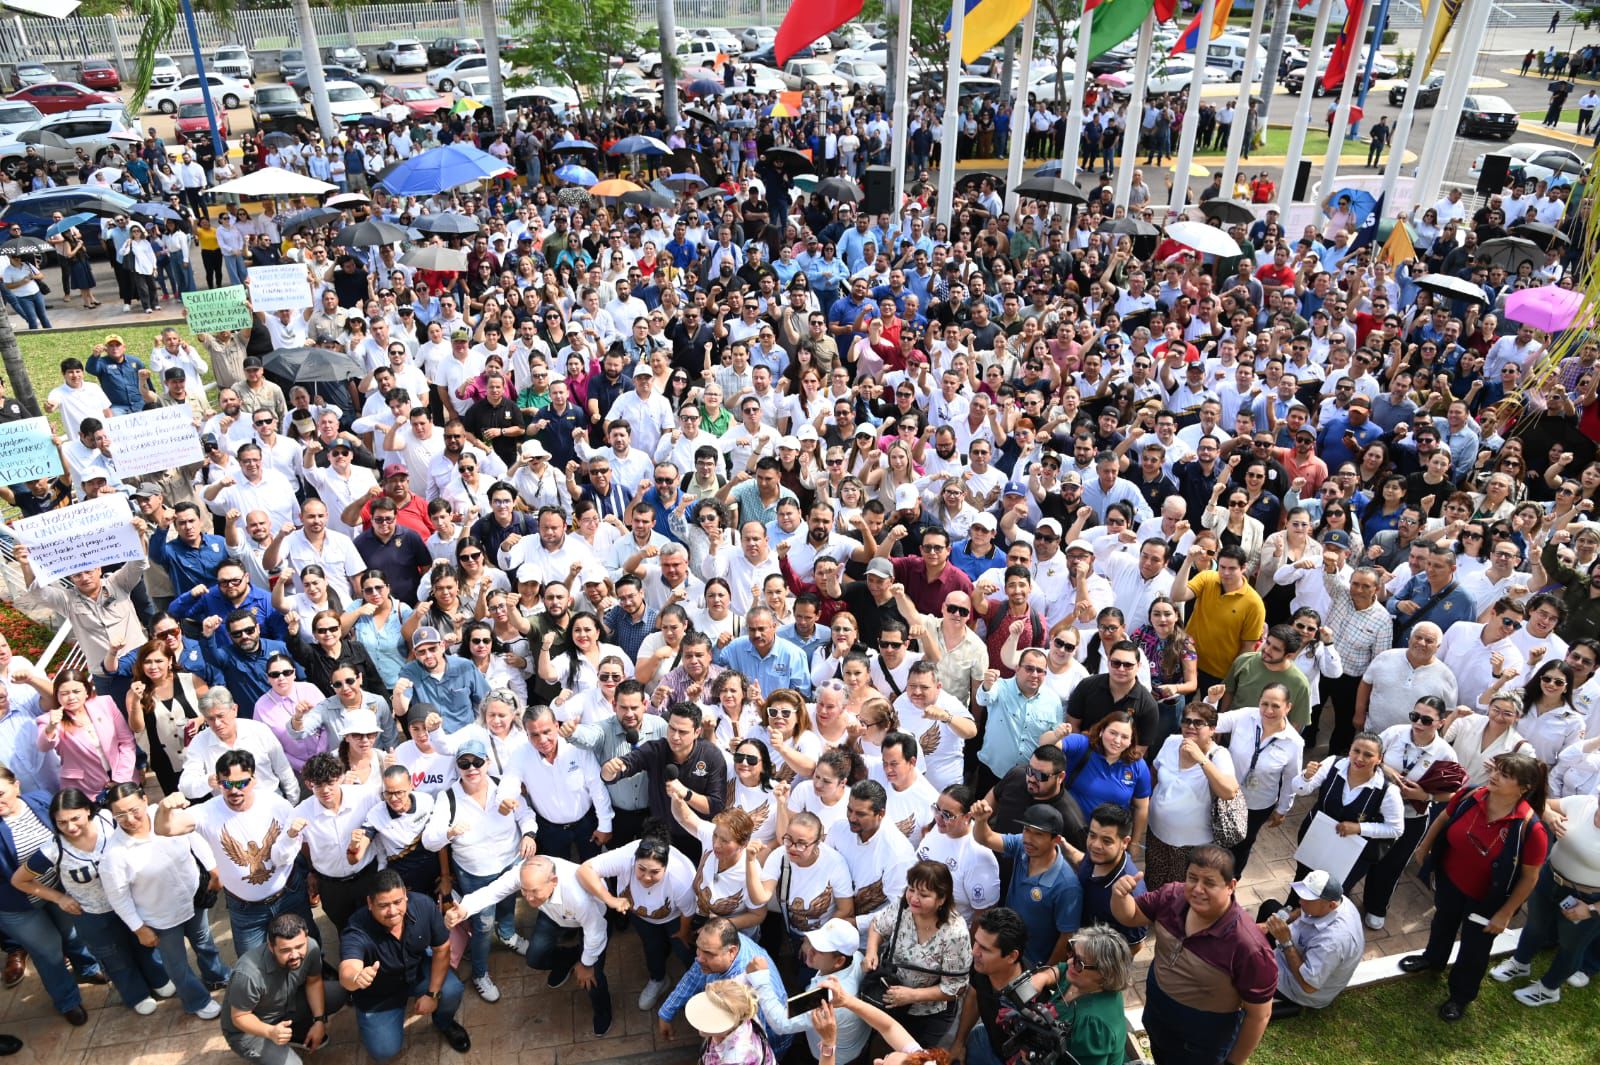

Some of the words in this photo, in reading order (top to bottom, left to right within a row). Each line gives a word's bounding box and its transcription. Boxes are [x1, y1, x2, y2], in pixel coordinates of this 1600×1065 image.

[41, 502, 108, 527] trabajadores
[122, 549, 140, 559] UAS
[423, 774, 444, 784] UAS
